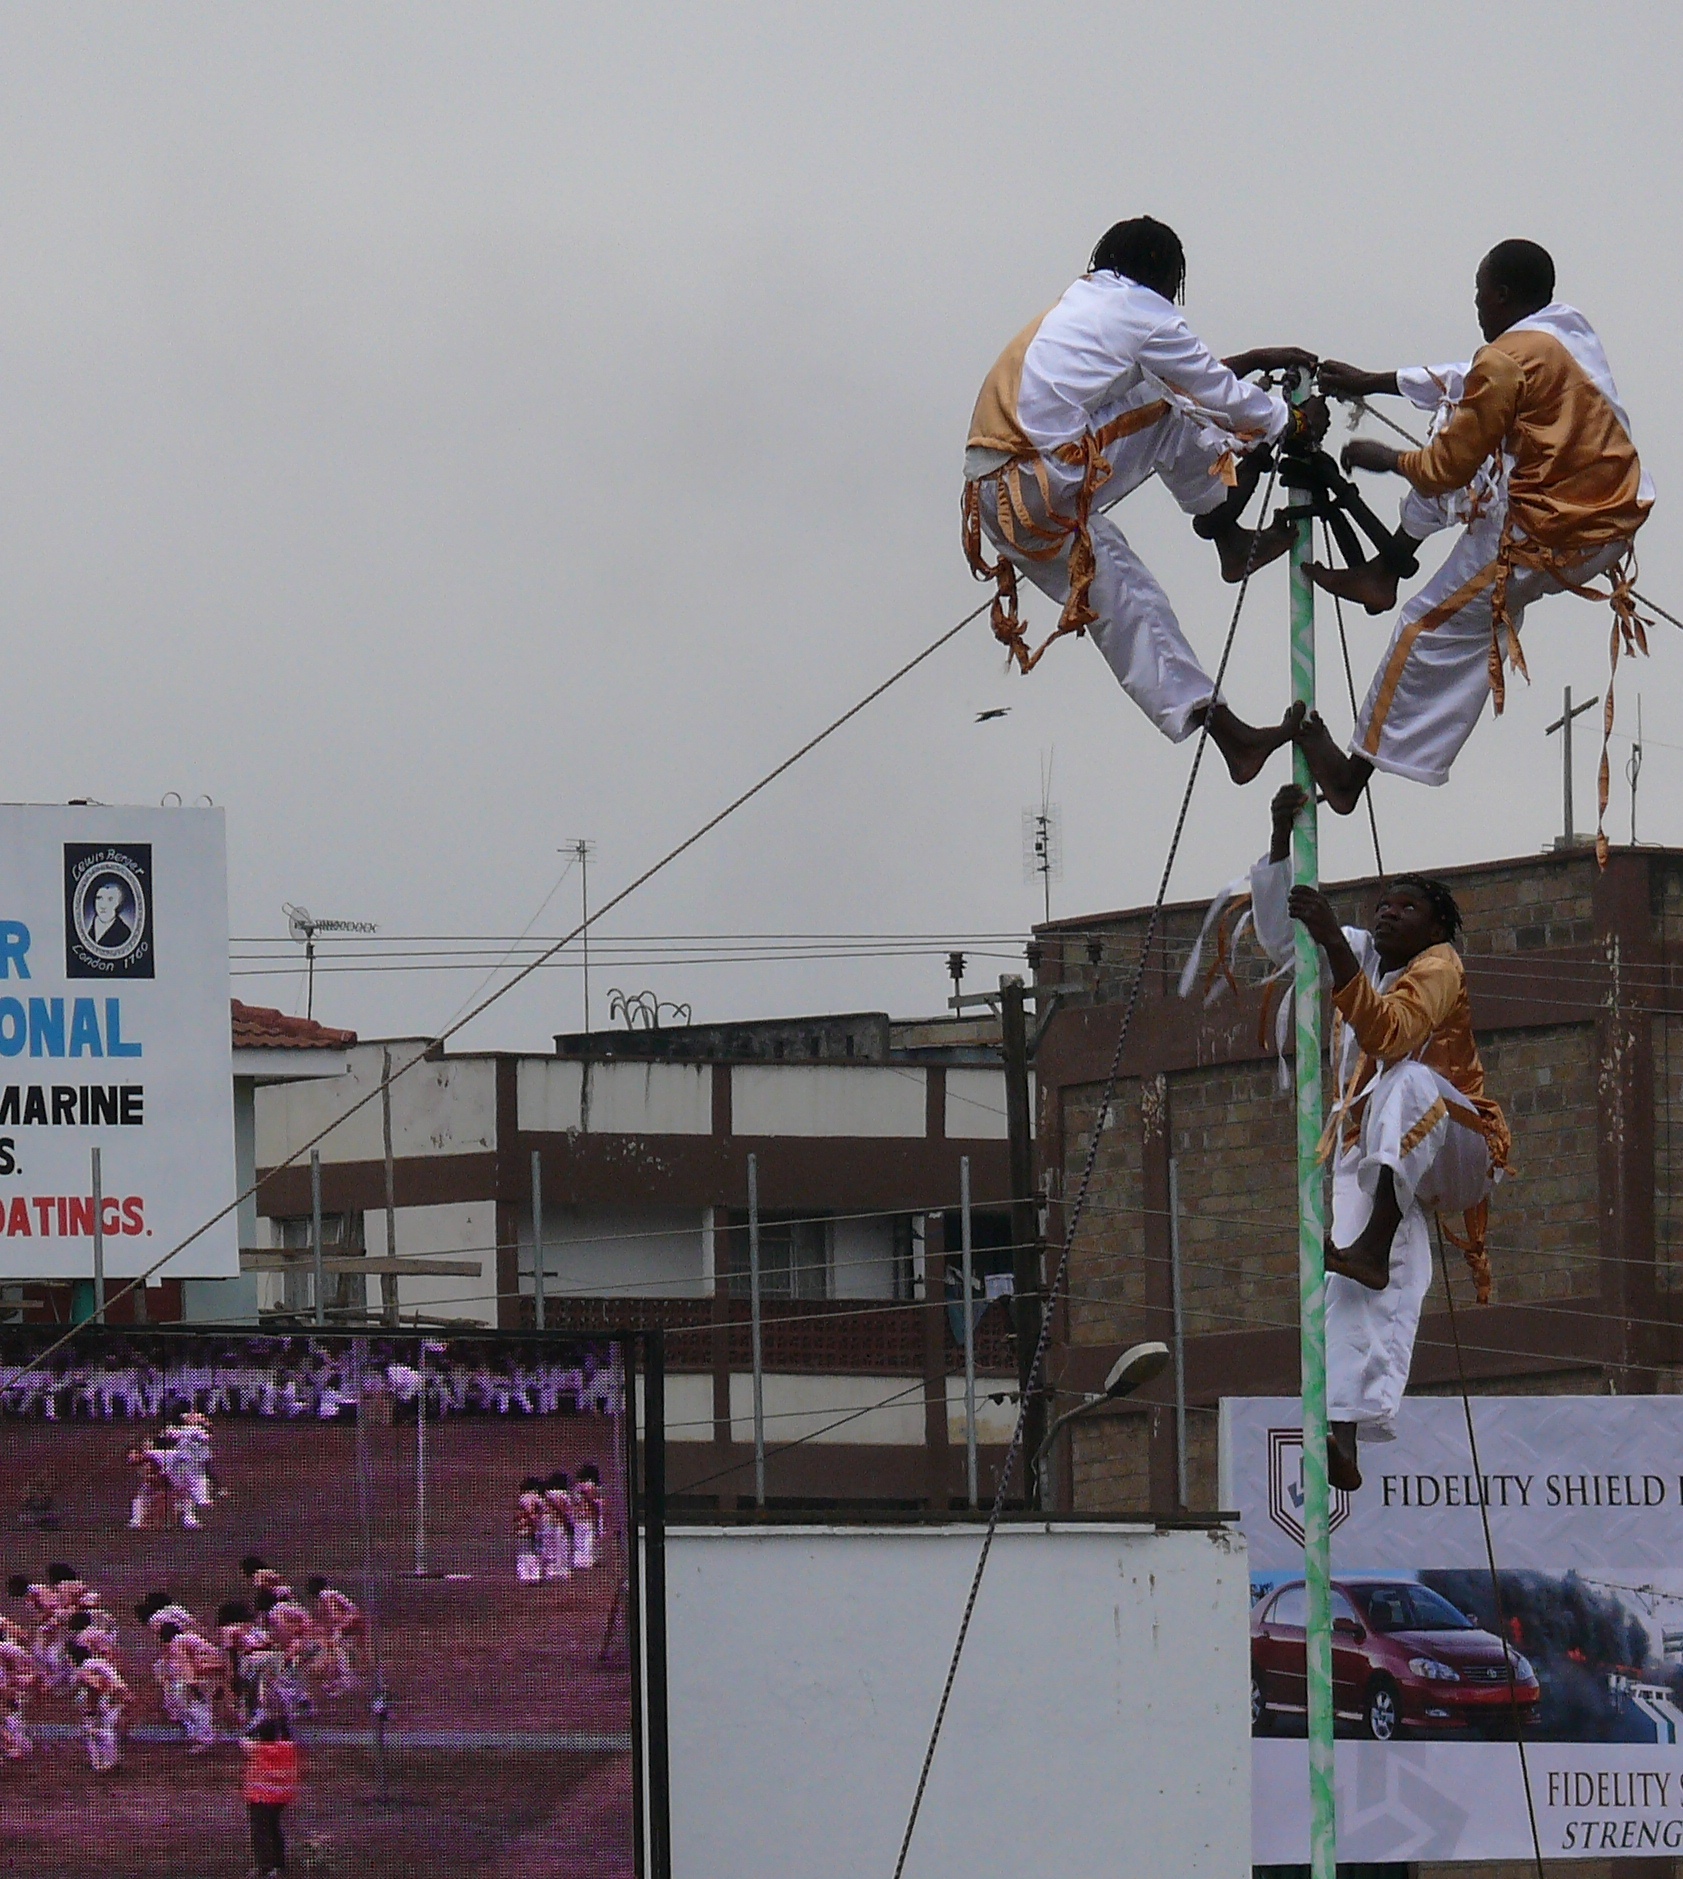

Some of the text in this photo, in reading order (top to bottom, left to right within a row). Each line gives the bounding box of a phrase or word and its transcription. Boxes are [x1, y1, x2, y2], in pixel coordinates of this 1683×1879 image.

[72, 848, 145, 881] Lewis Berger
[72, 941, 148, 972] London 1760
[0, 996, 142, 1058] ONAL
[0, 1196, 152, 1237] ATINGS.
[1381, 1475, 1534, 1507] FIDELITY
[1546, 1474, 1665, 1506] SHIELD
[1548, 1772, 1671, 1807] FIDELITY
[1562, 1820, 1683, 1849] STRENG
